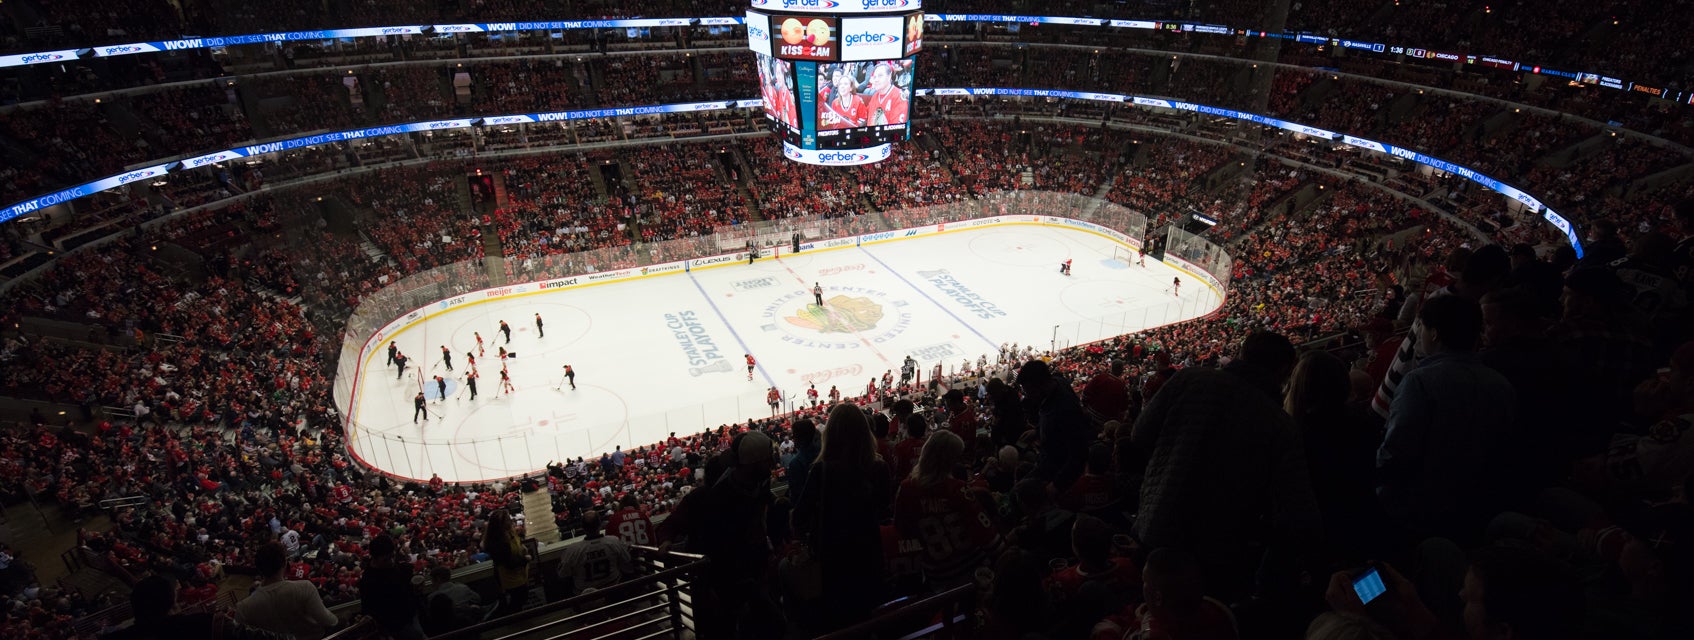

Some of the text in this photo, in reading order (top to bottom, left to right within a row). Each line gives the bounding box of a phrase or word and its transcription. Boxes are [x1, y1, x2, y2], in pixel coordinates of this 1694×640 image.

[945, 14, 967, 22] WOW!
[382, 27, 403, 35] gerber
[487, 23, 516, 31] WOW!
[564, 21, 582, 29] THAT
[583, 20, 612, 28] COMING.
[164, 31, 325, 51] WOW! DID NOT SEE THAT COMING.
[845, 31, 885, 46] gerber
[106, 46, 131, 55] gerber
[781, 45, 830, 56] KISS CAM
[1436, 52, 1459, 60] CHICAGO
[22, 54, 51, 64] gerber
[1633, 84, 1661, 95] PENALTIES
[538, 106, 664, 121] WOW! DID NOT SEE THAT COMING.
[1175, 101, 1198, 112] WOW!
[1199, 105, 1211, 113] DID
[1211, 107, 1225, 116] NOT
[1227, 110, 1237, 118] SEE
[1237, 111, 1253, 121] THAT
[430, 121, 451, 129] gerber
[493, 116, 513, 124] gerber
[246, 126, 402, 156] WOW! DID NOT SEE THAT COMING.
[193, 154, 217, 166] gerber
[819, 151, 856, 163] gerber
[1391, 145, 1415, 160] WOW!
[1417, 155, 1429, 165] DID
[1430, 158, 1445, 169] NOT
[1446, 162, 1458, 173] SEE
[1458, 166, 1475, 179] THAT
[118, 171, 146, 183] gerber
[12, 201, 38, 215] THAT
[40, 188, 85, 206] COMING.
[702, 256, 731, 265] LEXUS
[546, 278, 578, 289] impact
[487, 287, 512, 297] meijer
[449, 296, 465, 306] AT&T
[664, 313, 707, 366] STANLEY CUP
[679, 310, 724, 360] PLAYOFFS
[618, 519, 650, 546] 88
